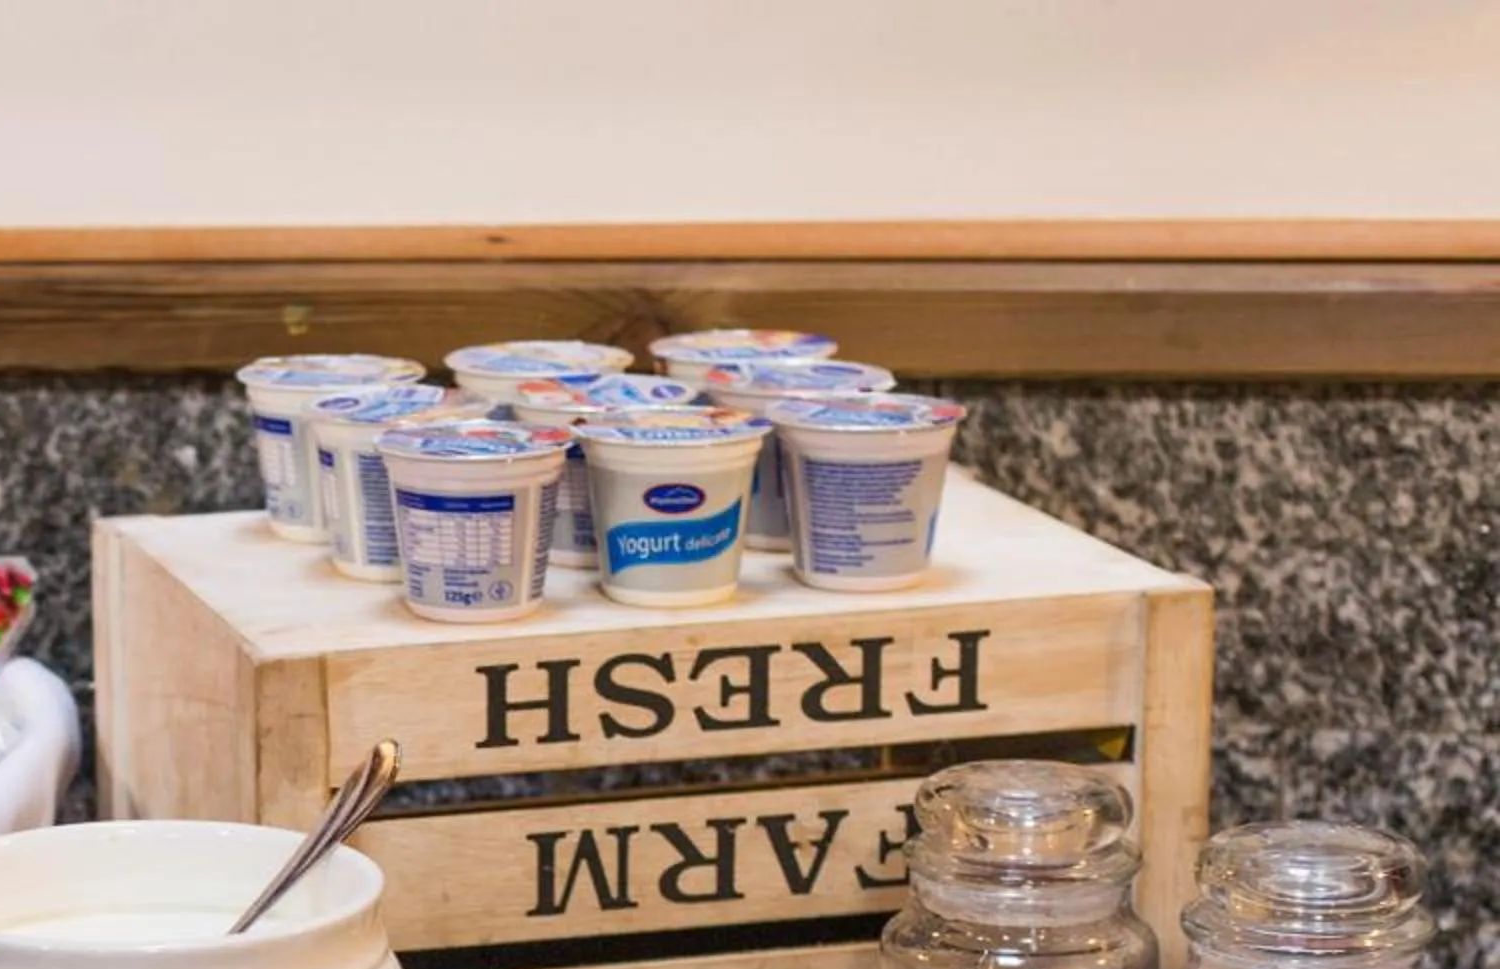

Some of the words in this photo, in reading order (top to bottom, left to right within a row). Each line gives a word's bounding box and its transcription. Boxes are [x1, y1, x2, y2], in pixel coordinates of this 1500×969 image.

[617, 532, 680, 559] Yogurt
[476, 630, 990, 749] FRESH
[526, 803, 924, 917] FARM
